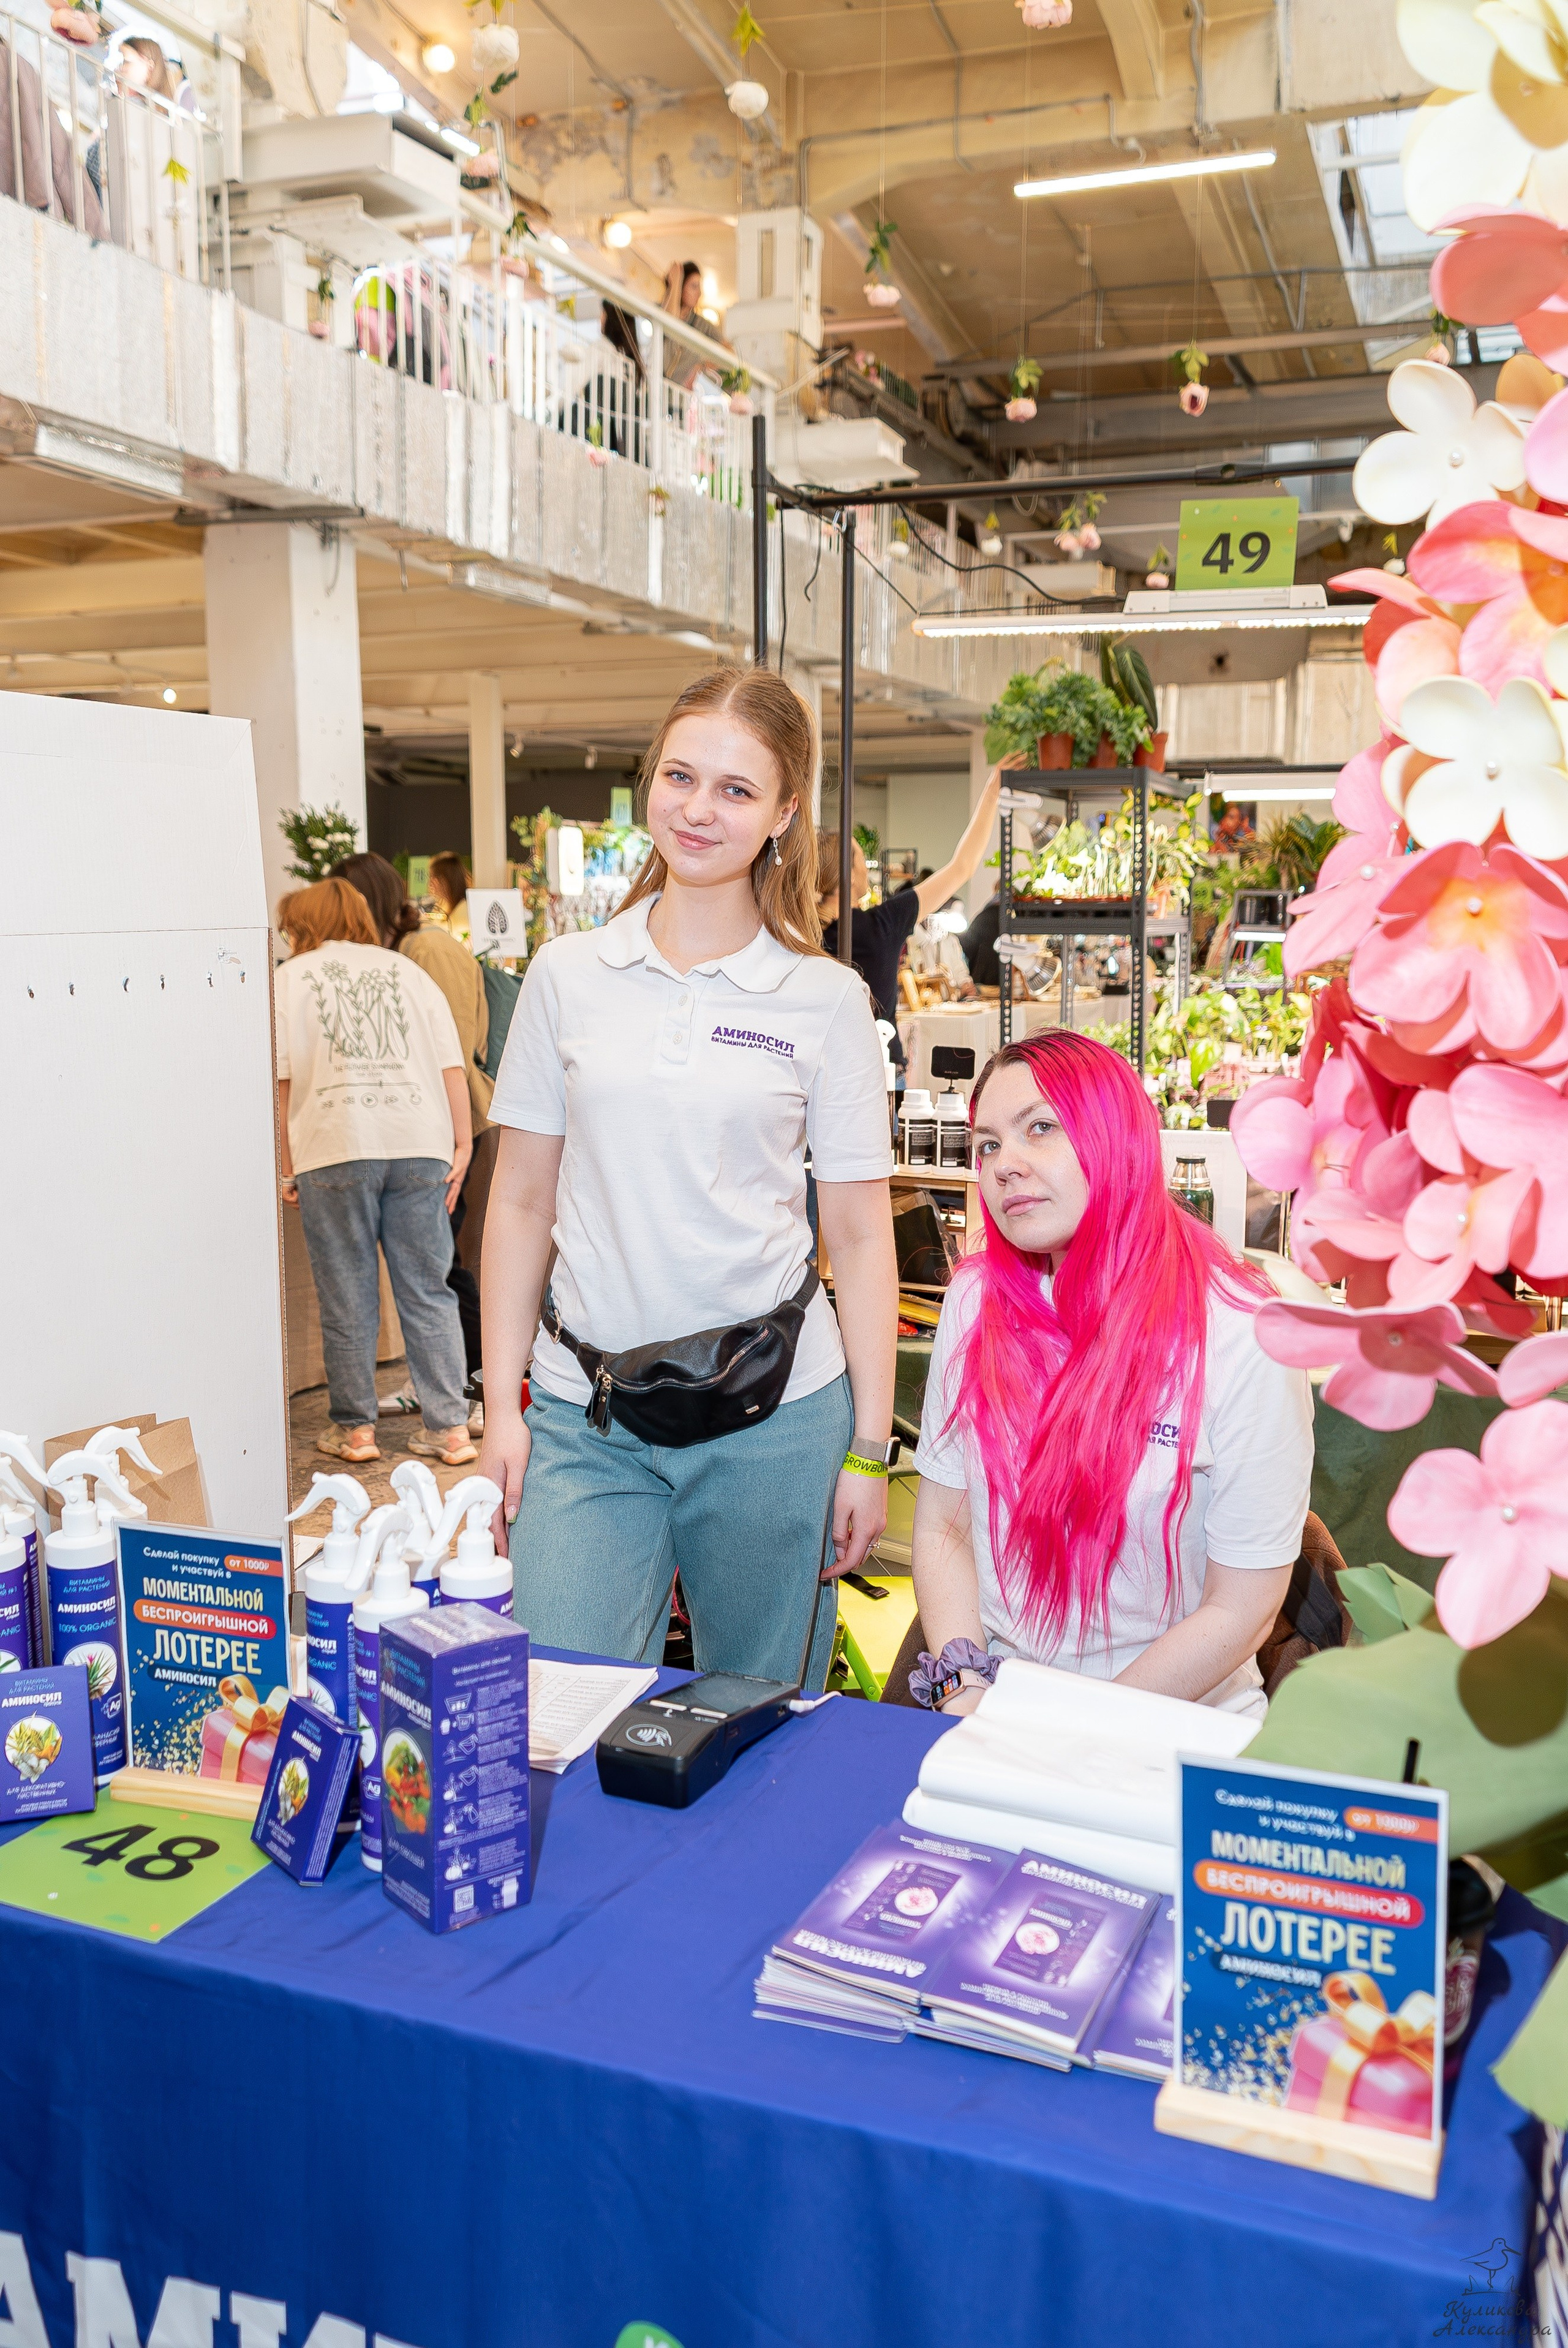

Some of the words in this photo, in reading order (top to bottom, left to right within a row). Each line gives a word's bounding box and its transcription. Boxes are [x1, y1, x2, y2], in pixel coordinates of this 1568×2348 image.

[1202, 532, 1270, 574] 49
[711, 1036, 747, 1047] ВИТАМИНЫ
[763, 1045, 793, 1059] РАСТЕНИЙ
[712, 1026, 795, 1053] АМИНОСИЛ
[143, 1546, 179, 1560] Сделай
[181, 1553, 219, 1566] покупку
[229, 1558, 241, 1568] от
[179, 1565, 224, 1579] участвуй
[58, 1596, 116, 1613] АМИНОСИЛ
[143, 1577, 263, 1612] МОМЕНТАЛЬНОЙ
[59, 1623, 77, 1633] 100%
[79, 1617, 116, 1633] ORGANIC
[141, 1605, 268, 1634] БЕСПРОИГРЫШНОЙ
[153, 1628, 262, 1675] ЛОТЕРЕЕ
[154, 1667, 217, 1688] АМИНОСИЛ
[1, 1691, 62, 1708] АМИНОСИЛ
[381, 1680, 432, 1723] АМИНОСИЛ
[292, 1730, 322, 1756] АМИНОСИЛ
[1215, 1788, 1273, 1811] Сделай
[1275, 1799, 1339, 1823] покупку
[1351, 1812, 1372, 1827] от
[1272, 1816, 1343, 1841] участвуй
[61, 1824, 219, 1881] 48
[1211, 1829, 1407, 1890] МОМЕНТАЛЬНОЙ
[1206, 1868, 1412, 1921] БЕСПРОИГРЫШНОЙ
[1220, 1901, 1397, 1976] ЛОТЕРЕЕ
[1219, 1954, 1322, 1988] АМИНОСИЛ
